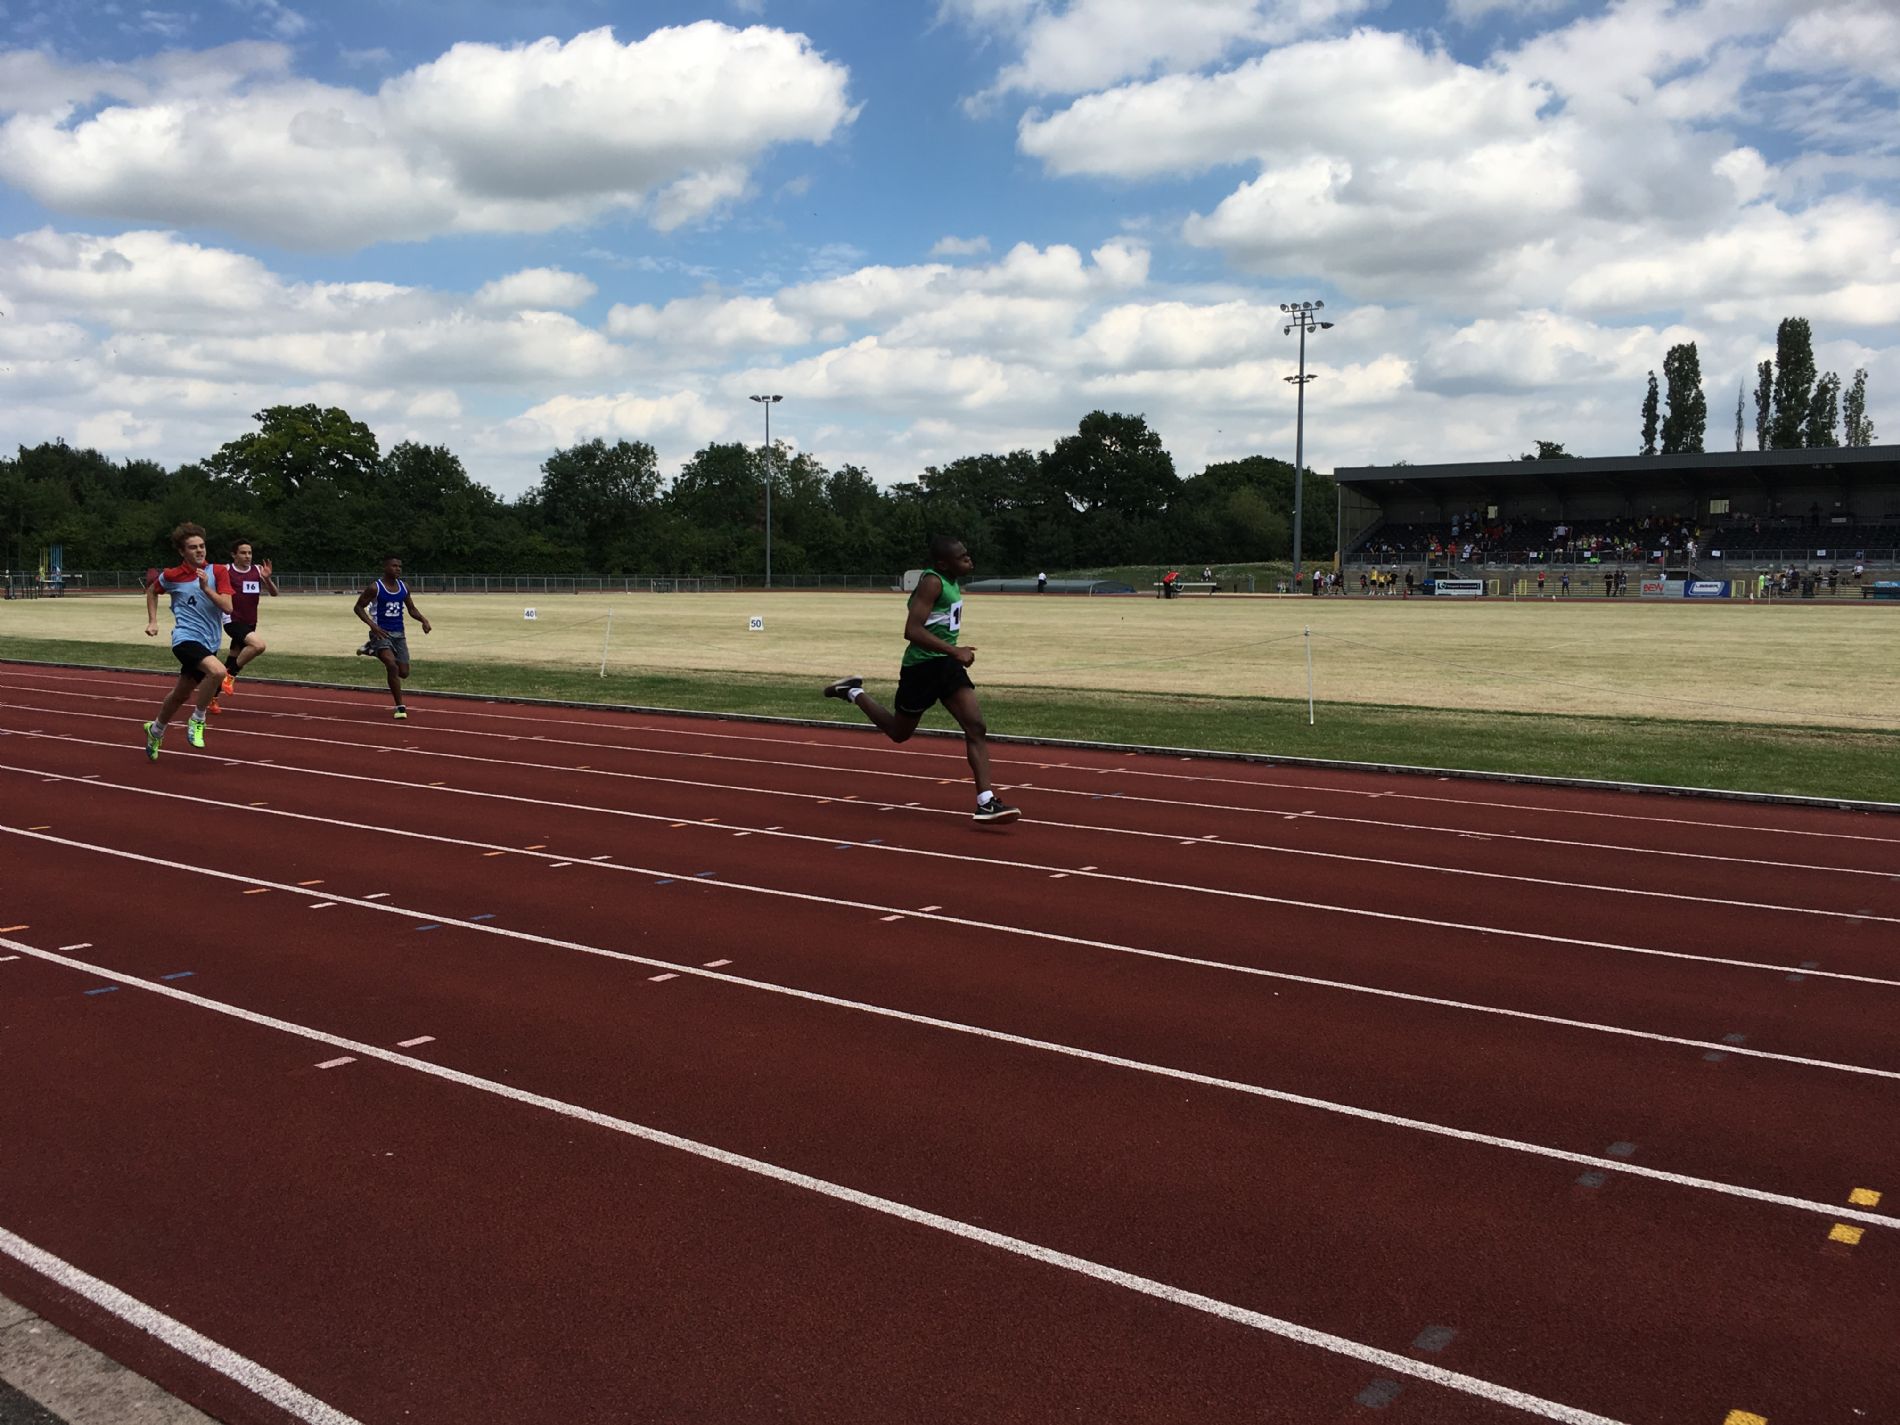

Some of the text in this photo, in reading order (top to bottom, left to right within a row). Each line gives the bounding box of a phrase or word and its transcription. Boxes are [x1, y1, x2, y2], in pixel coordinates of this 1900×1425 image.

[187, 596, 197, 606] 4
[953, 606, 962, 625] 1
[751, 619, 762, 628] 50
